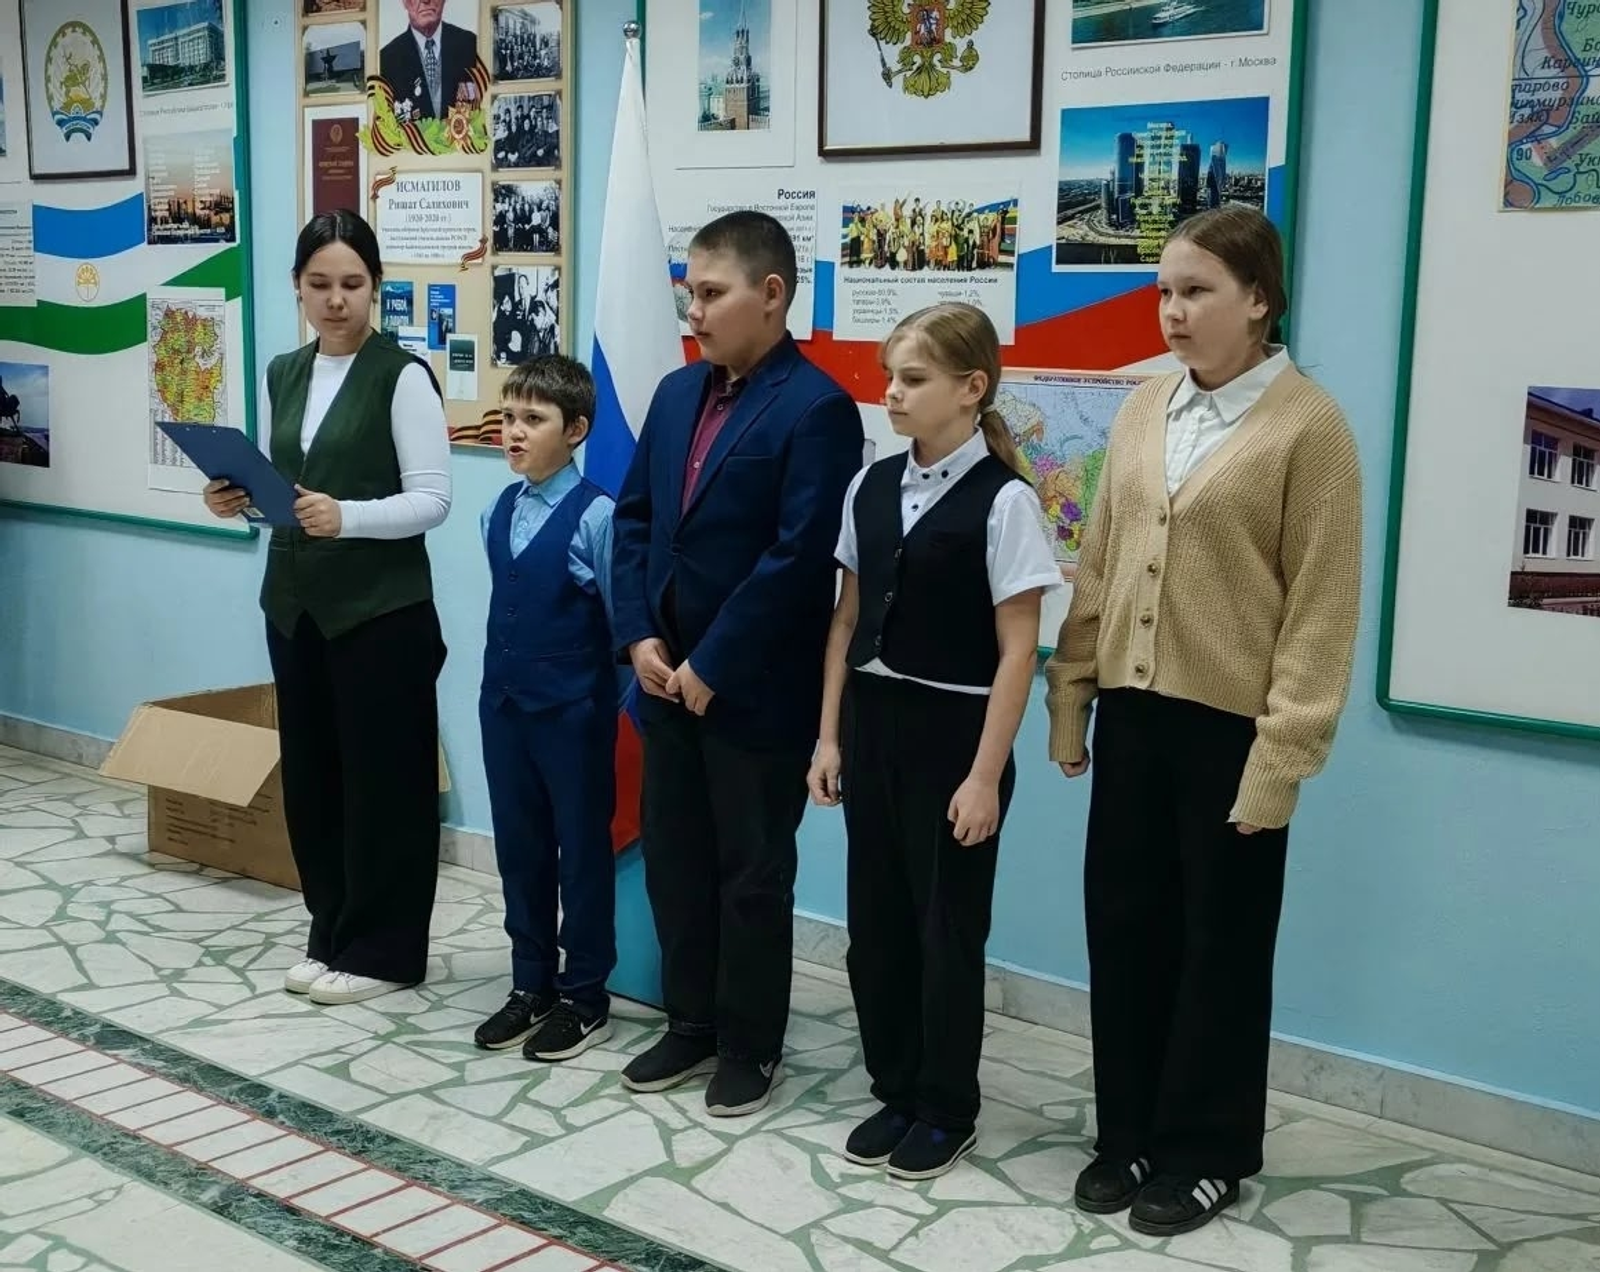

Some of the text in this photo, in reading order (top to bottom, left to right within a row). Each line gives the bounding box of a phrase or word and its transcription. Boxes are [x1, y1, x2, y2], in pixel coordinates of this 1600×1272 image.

[1061, 70, 1103, 81] Столица
[1163, 62, 1221, 74] Федерации
[1516, 147, 1533, 161] 90
[396, 180, 462, 193] ИСМАГИЛОВ
[777, 188, 816, 200] Россия
[388, 197, 469, 210] Ришат Салихович
[843, 275, 998, 284] Национальный состав населения России
